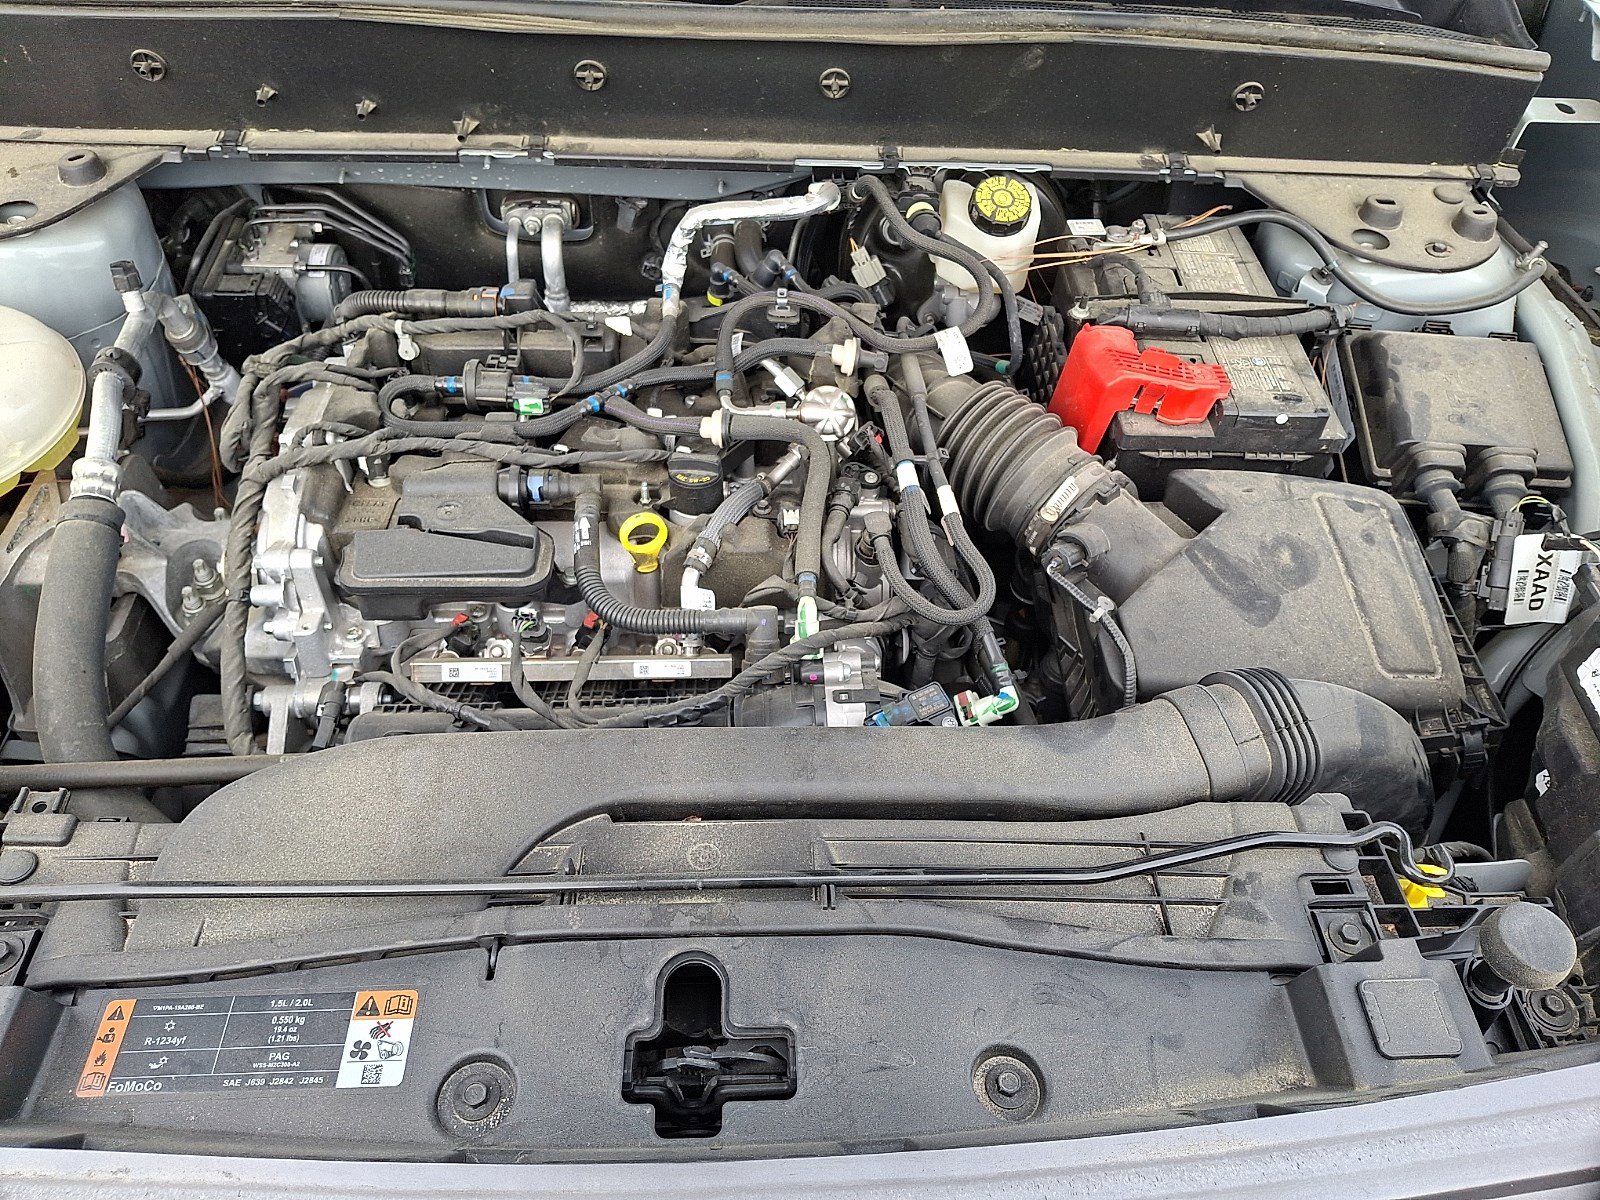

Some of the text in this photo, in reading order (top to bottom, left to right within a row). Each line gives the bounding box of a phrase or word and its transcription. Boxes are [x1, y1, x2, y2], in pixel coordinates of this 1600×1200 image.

[1528, 553, 1554, 612] XAAD
[270, 999, 288, 1008] 1.5L
[295, 998, 314, 1007] 2.0L
[271, 1015, 306, 1026] 0.550 kg
[273, 1026, 288, 1034] 19.4
[144, 1035, 188, 1047] R-1234yf
[267, 1034, 300, 1044] (1.21 lbs)
[268, 1051, 290, 1061] PAG
[106, 1079, 163, 1093] FoMoCo
[222, 1076, 324, 1087] SAE J639 J2842 J2845
